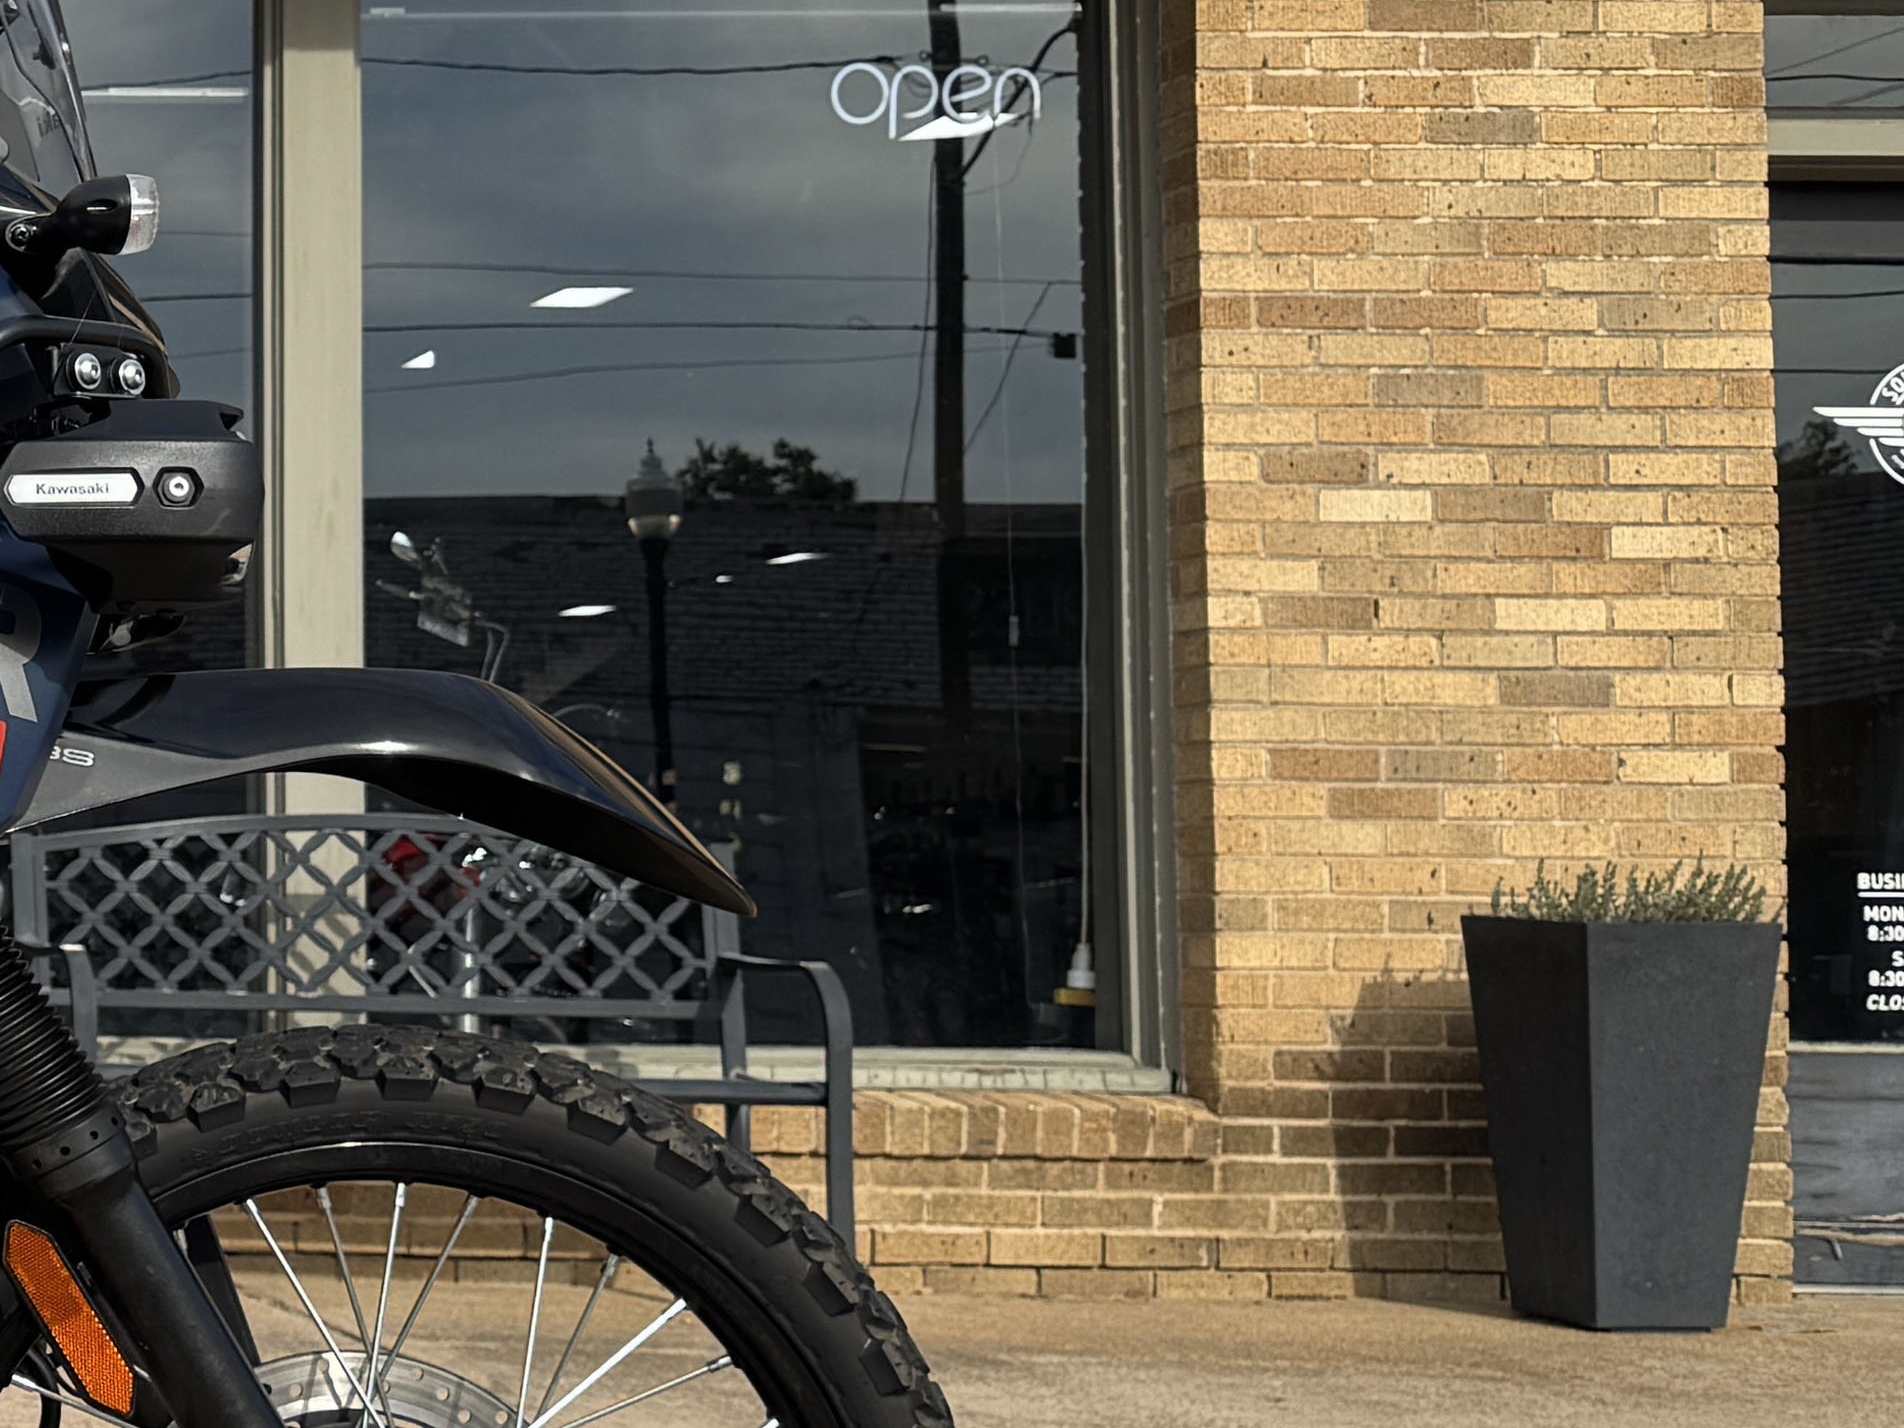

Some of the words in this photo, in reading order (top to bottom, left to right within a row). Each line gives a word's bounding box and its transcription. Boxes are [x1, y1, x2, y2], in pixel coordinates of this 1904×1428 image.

[830, 61, 1042, 140] open
[35, 482, 110, 496] Kawasaki
[1856, 872, 1904, 890] BUSI
[1865, 993, 1904, 1011] CLO
